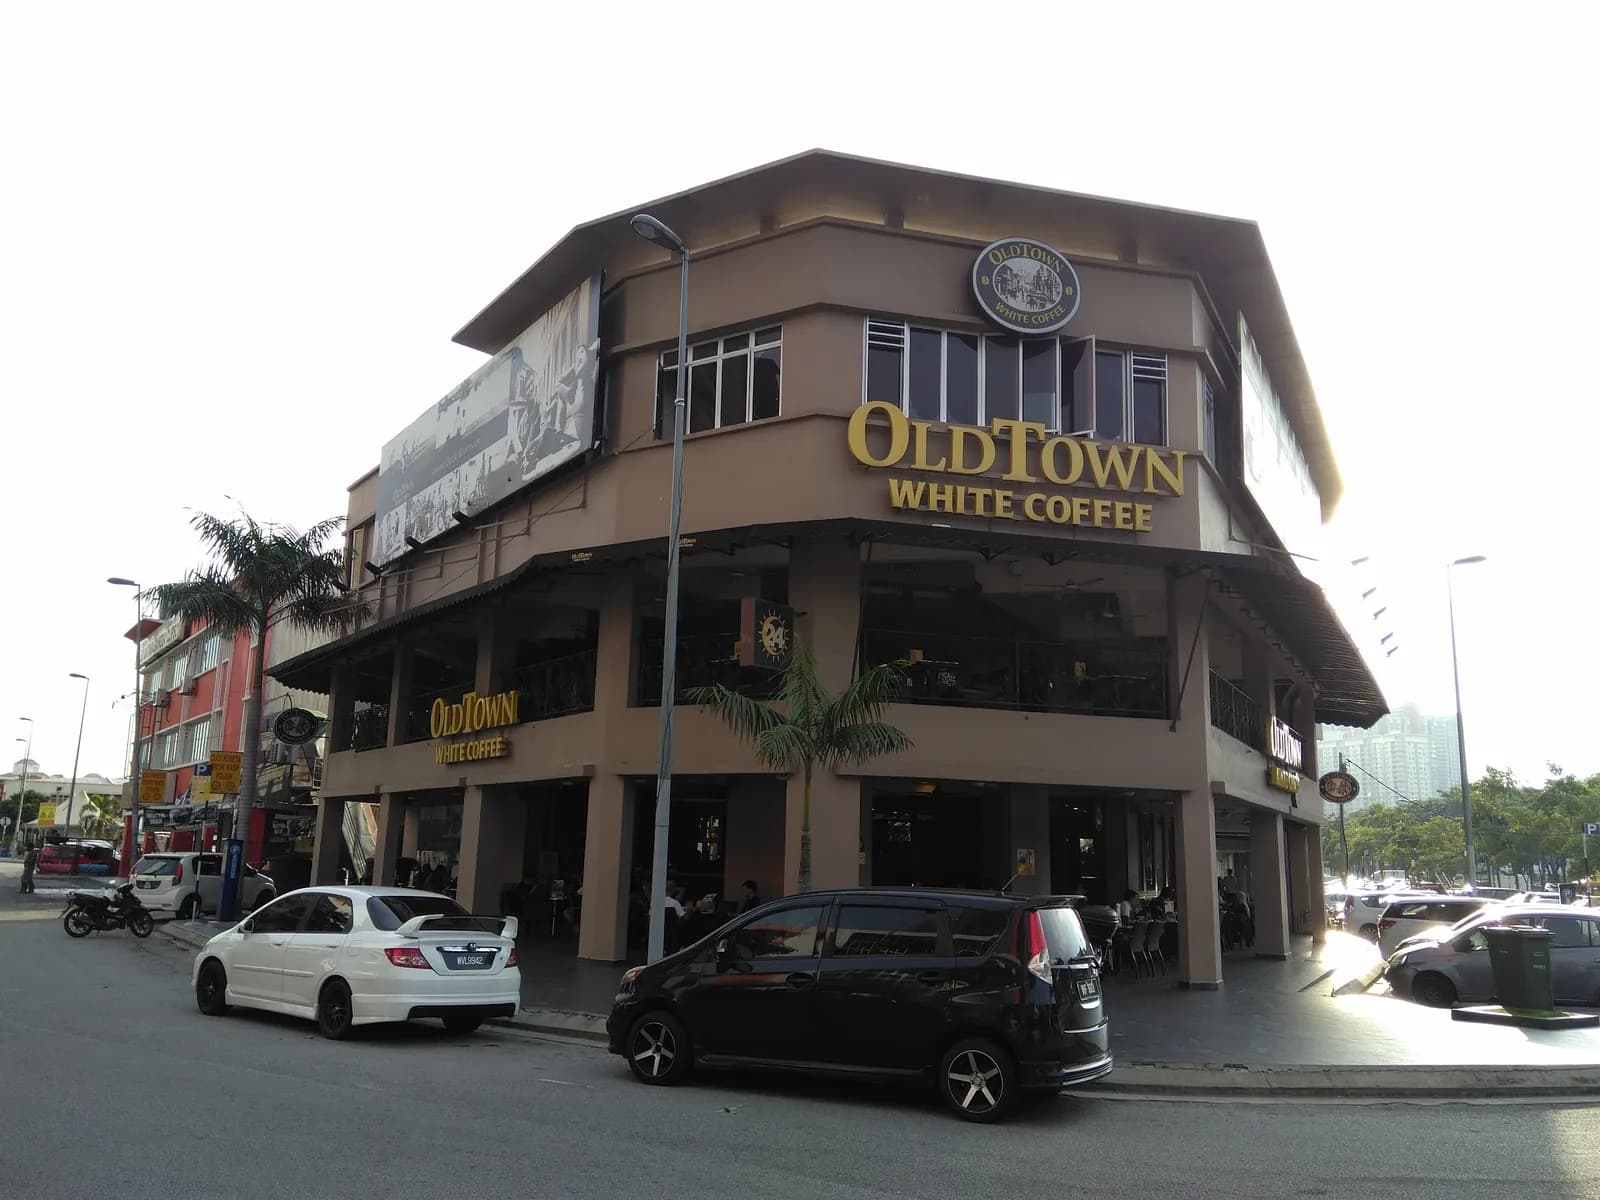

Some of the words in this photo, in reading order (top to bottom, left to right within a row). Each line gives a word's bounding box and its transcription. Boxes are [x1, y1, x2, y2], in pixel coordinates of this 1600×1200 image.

[989, 243, 1065, 274] OLDTOWN
[995, 301, 1029, 324] WHITE
[1032, 304, 1066, 325] COFFEE
[847, 400, 1187, 497] OLDTOWN
[887, 478, 1015, 518] WHITE
[1023, 492, 1153, 532] COFFEE
[430, 690, 521, 739] OLDTOWN
[434, 742, 466, 765] WHITE
[466, 736, 506, 762] COFFEE
[197, 765, 207, 776] P
[1587, 823, 1597, 835] P
